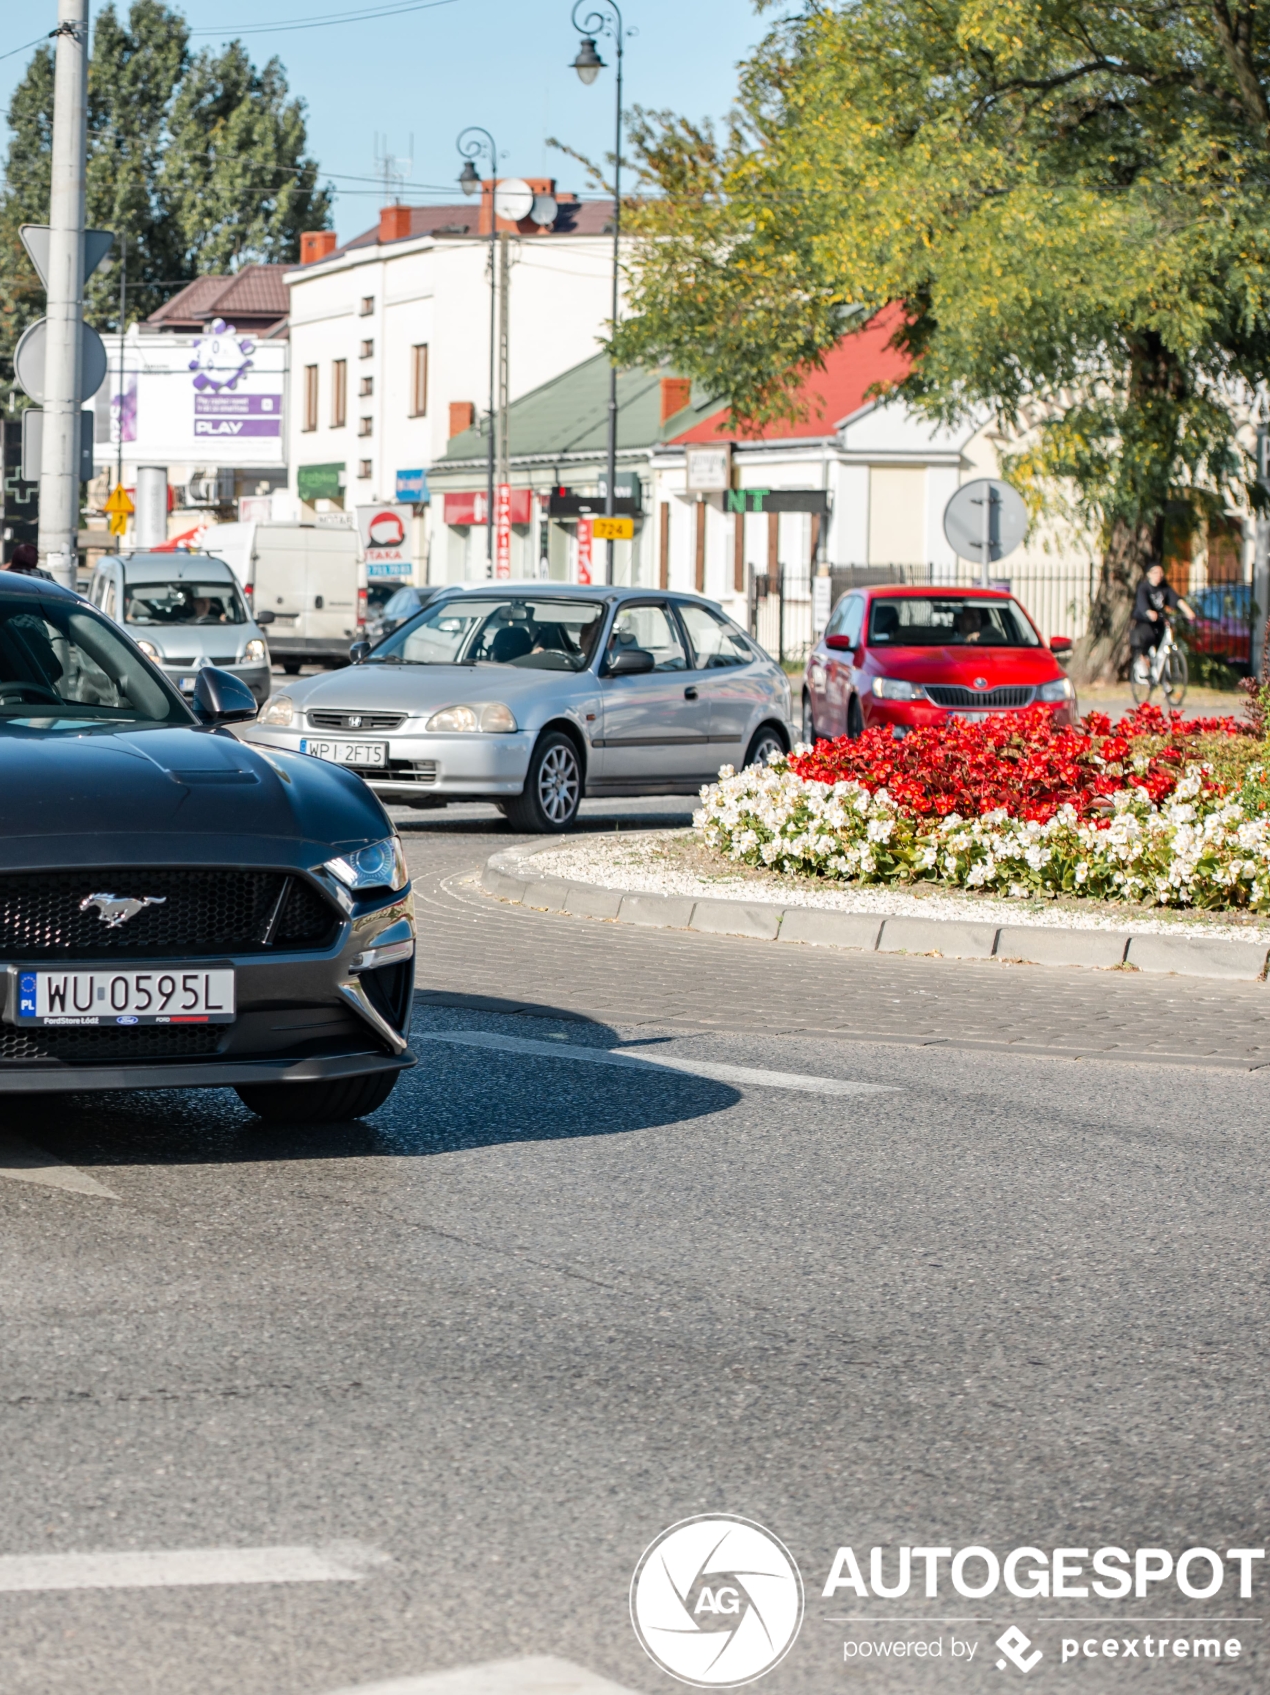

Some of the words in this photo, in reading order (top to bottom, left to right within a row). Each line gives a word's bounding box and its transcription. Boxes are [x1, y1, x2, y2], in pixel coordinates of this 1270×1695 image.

[195, 421, 244, 435] PLAY
[727, 489, 771, 513] NT
[599, 522, 624, 535] 724
[309, 743, 338, 760] WPI
[47, 975, 94, 1012] WU
[110, 974, 223, 1012] 0595L
[21, 999, 35, 1011] PL
[43, 1017, 81, 1025] FordStore
[81, 1016, 99, 1024] Łódź
